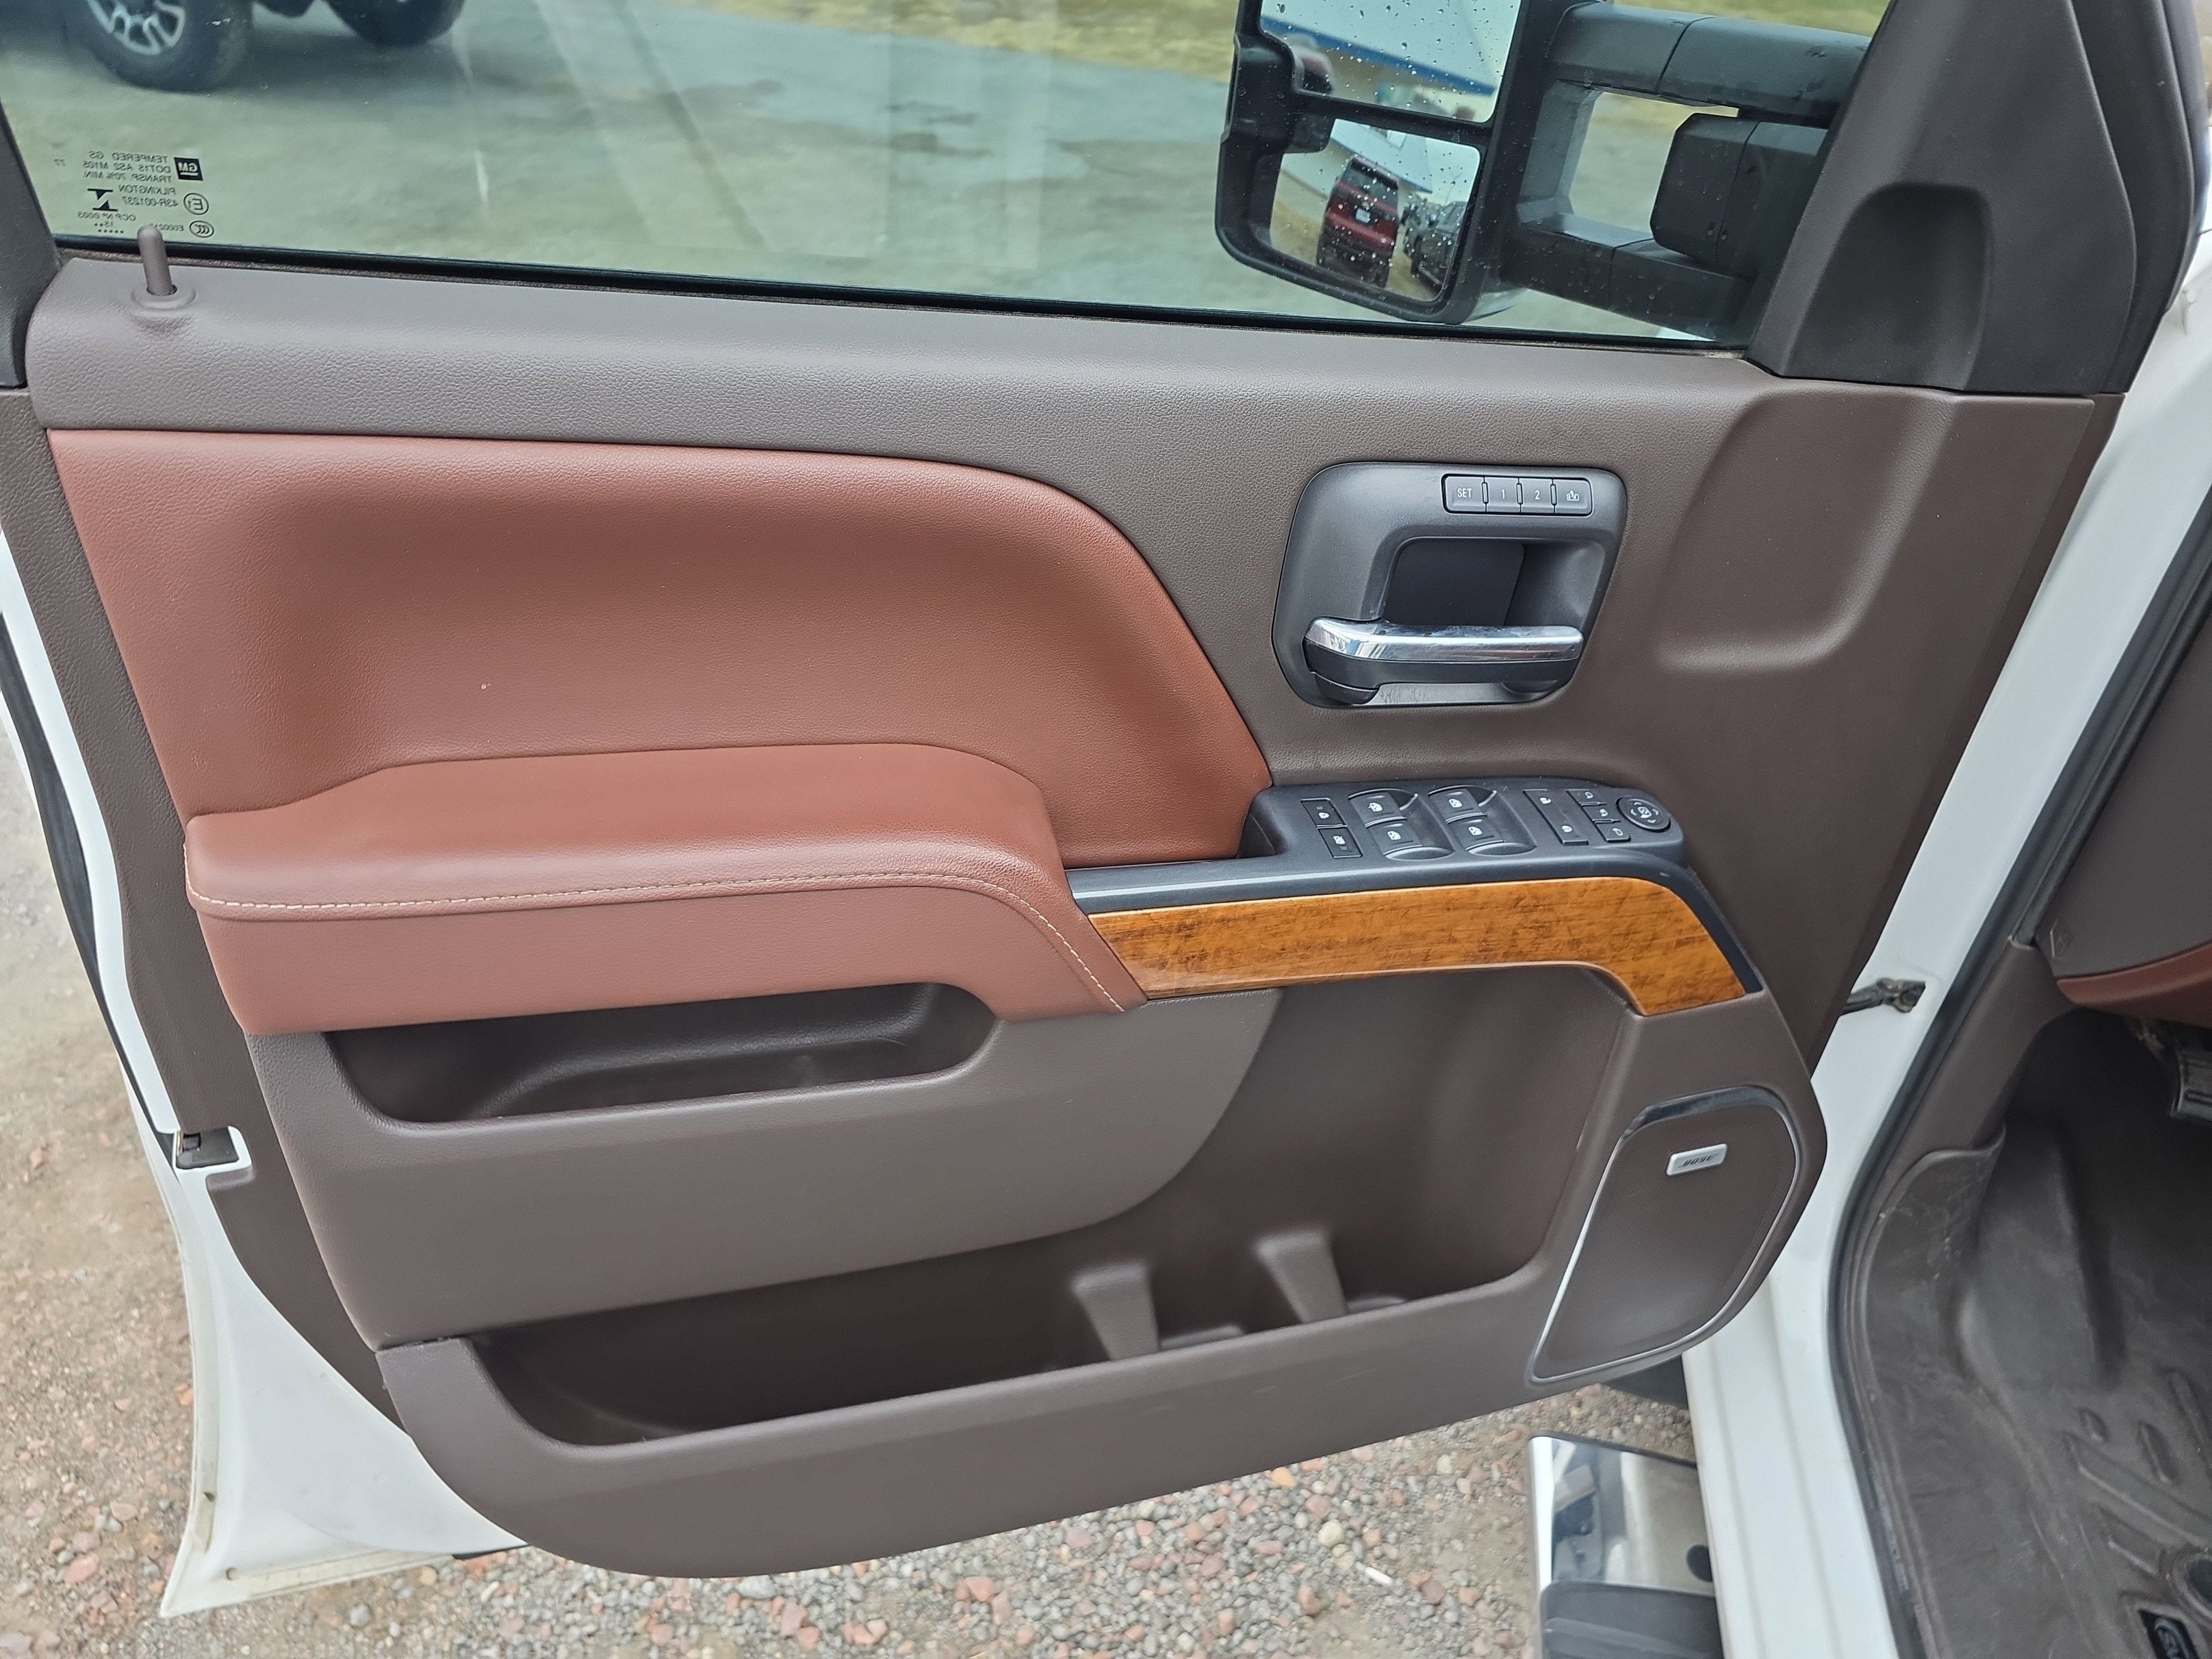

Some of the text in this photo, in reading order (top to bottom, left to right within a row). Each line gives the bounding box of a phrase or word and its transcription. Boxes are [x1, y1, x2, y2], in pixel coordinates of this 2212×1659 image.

[1457, 488, 1472, 498] SET
[1501, 489, 1506, 498] 1
[1534, 490, 1540, 500] 2
